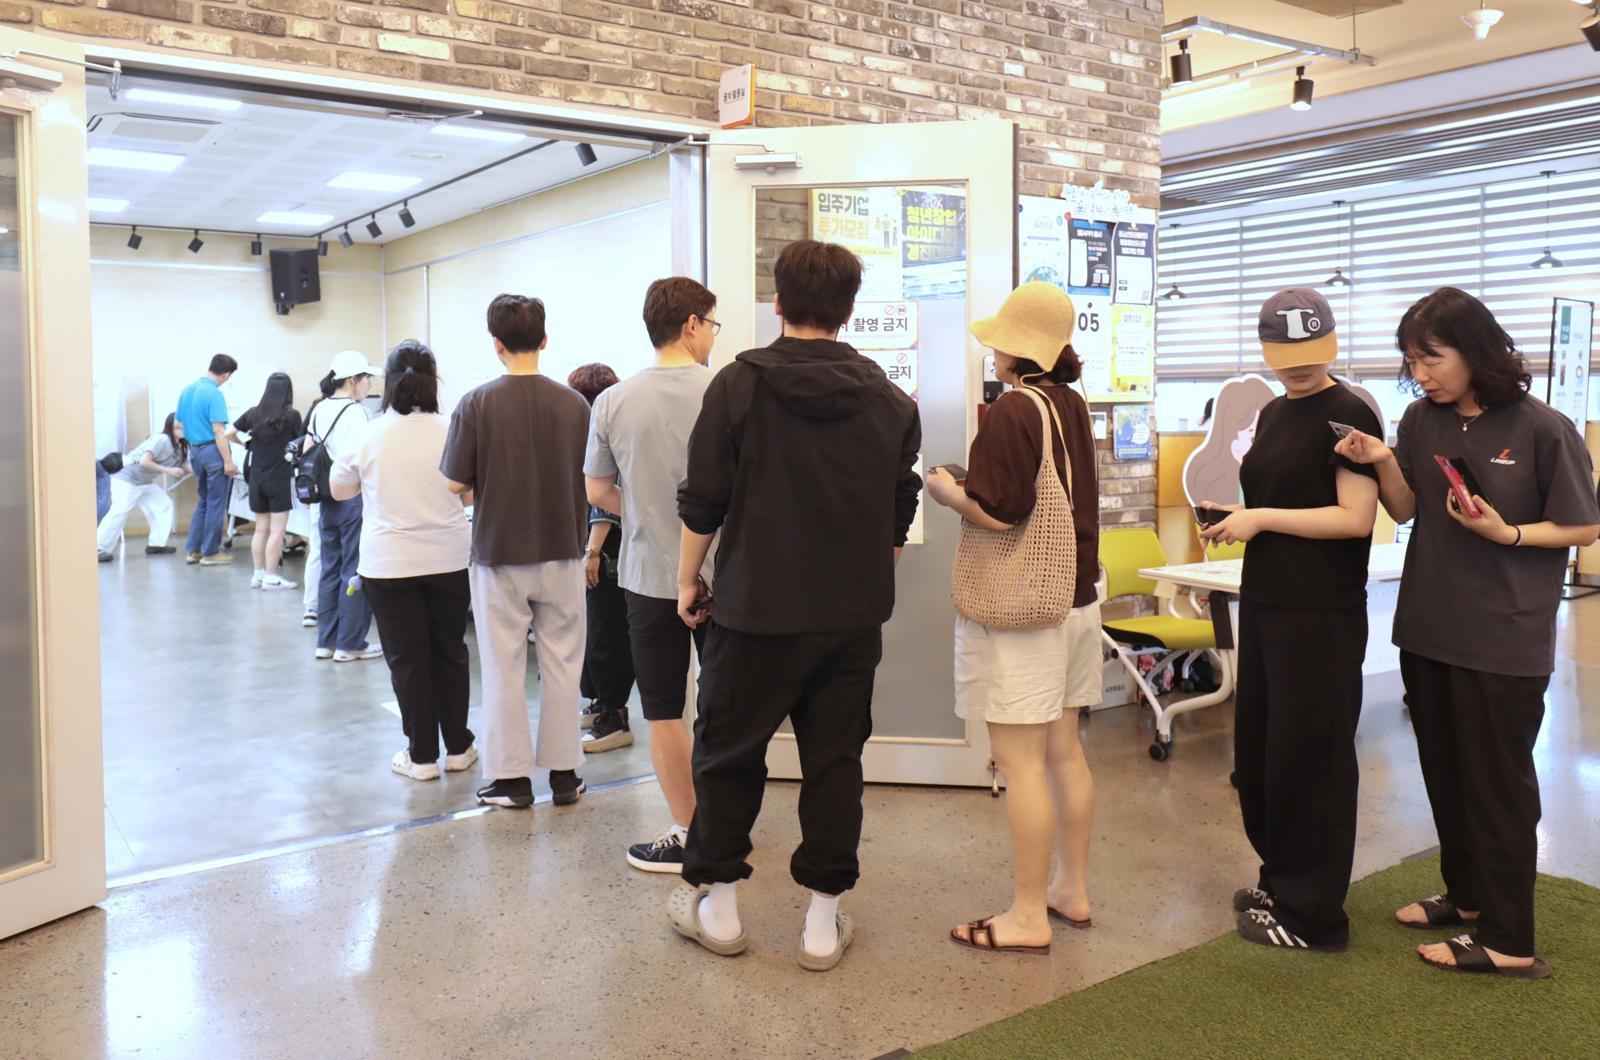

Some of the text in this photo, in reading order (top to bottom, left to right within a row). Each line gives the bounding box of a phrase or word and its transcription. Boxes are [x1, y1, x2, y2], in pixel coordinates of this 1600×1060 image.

[818, 192, 869, 217] 입주기업
[853, 317, 879, 332] 촬영
[882, 317, 908, 332] 금지
[1078, 312, 1100, 332] 05
[887, 365, 912, 380] 금지
